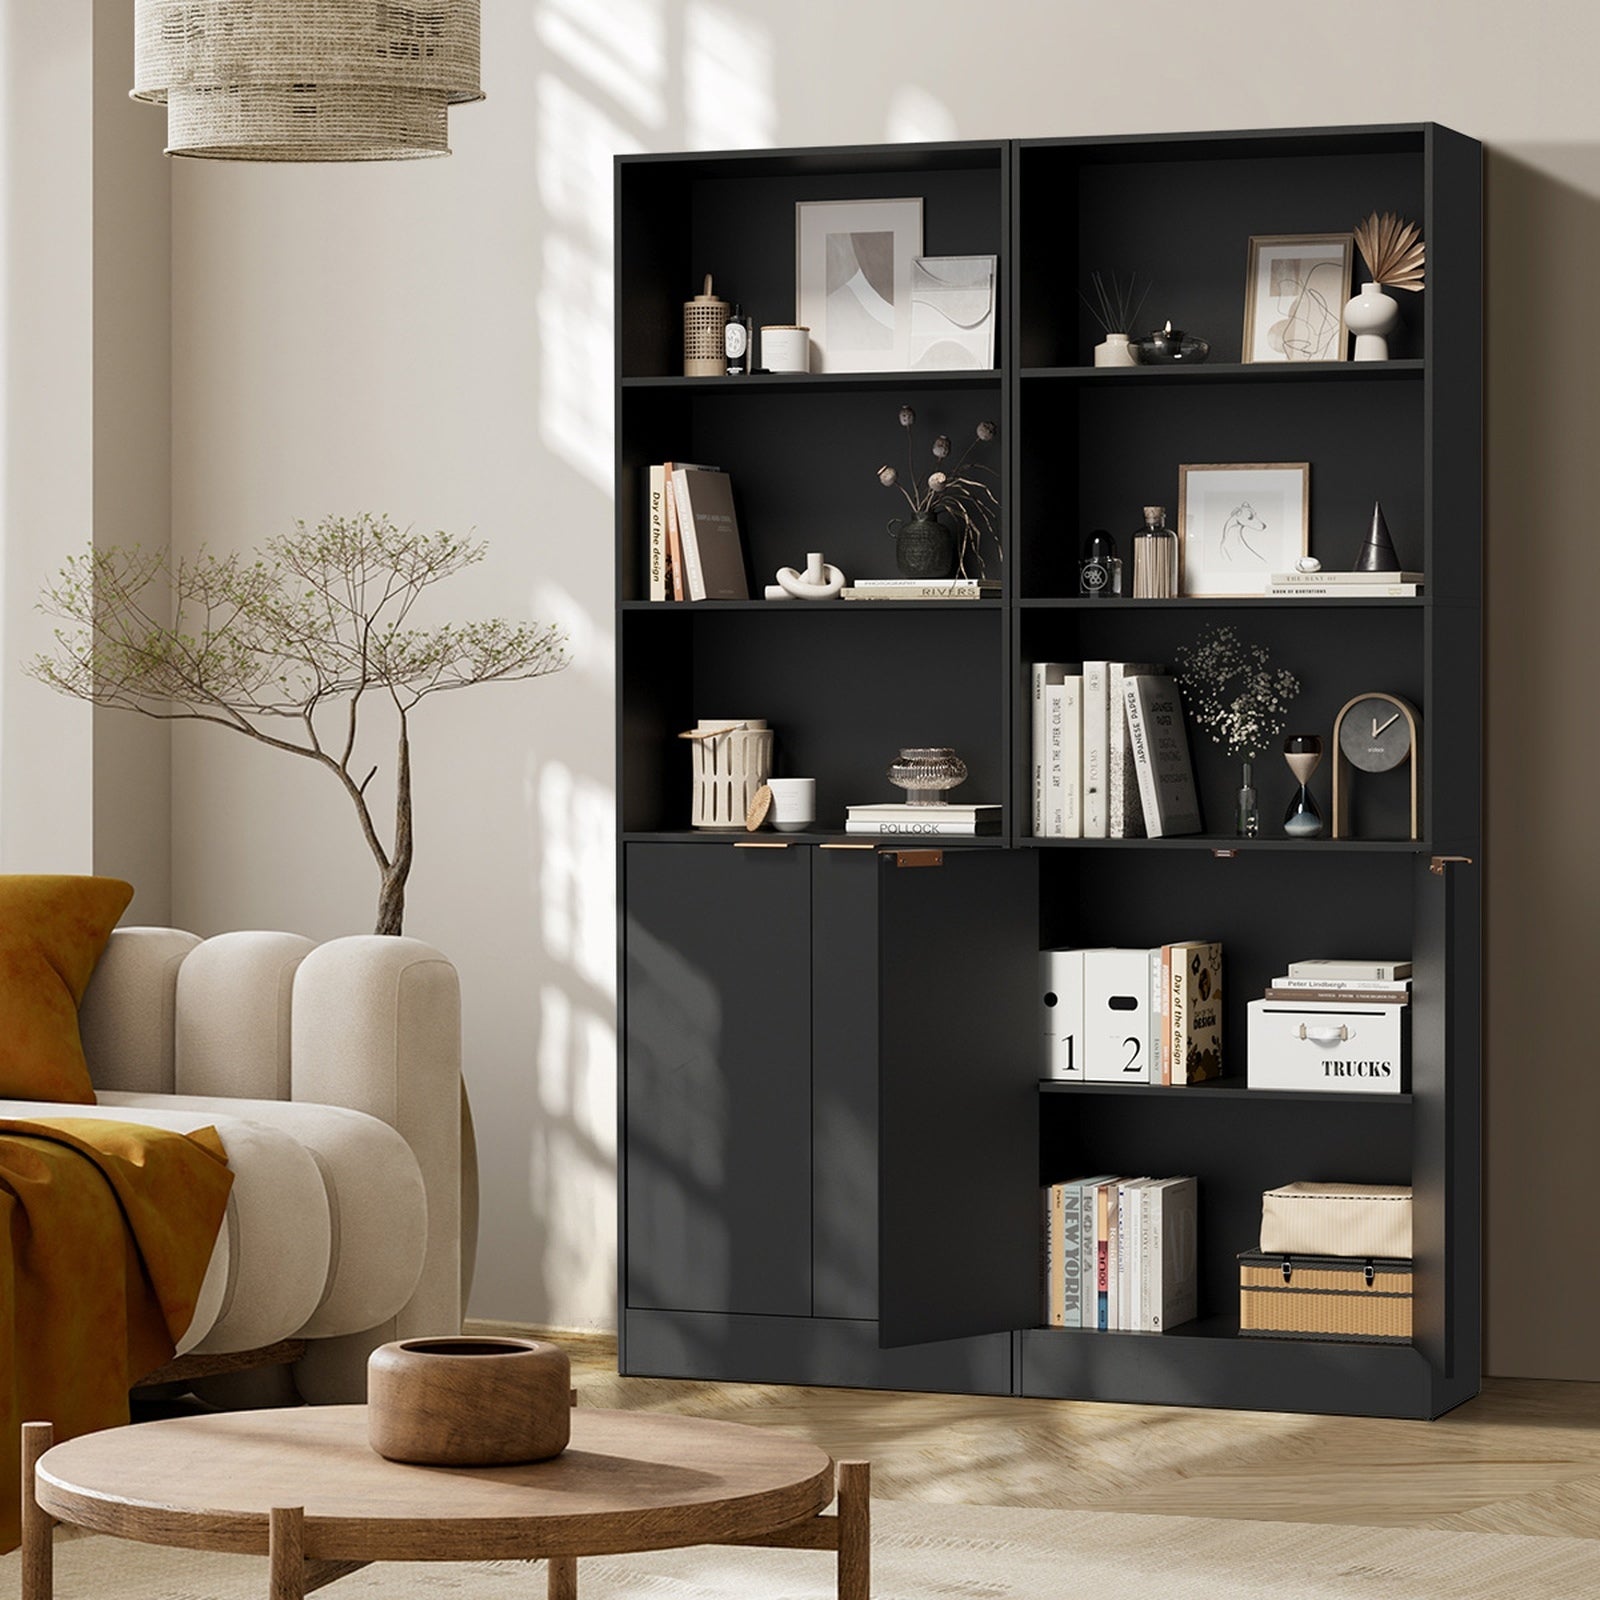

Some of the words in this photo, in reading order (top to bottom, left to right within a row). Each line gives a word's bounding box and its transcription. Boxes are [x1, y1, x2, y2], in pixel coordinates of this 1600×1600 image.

[652, 491, 661, 513] Day
[652, 514, 661, 527] of
[652, 528, 661, 545] the
[651, 547, 661, 582] design
[921, 588, 976, 596] RIVERS
[1052, 697, 1061, 724] CULTURE
[1127, 692, 1139, 720] PAPER
[1052, 727, 1061, 746] AFTER
[1132, 723, 1147, 764] JAPANESE
[1052, 750, 1061, 761] THE
[1090, 749, 1098, 781] POEMS
[1052, 764, 1061, 772] IN
[1052, 776, 1061, 787] ART
[879, 823, 941, 834] POLLOCK
[1172, 974, 1183, 996] Day
[1287, 980, 1307, 988] Peter
[1308, 981, 1347, 989] Lindbergh
[1173, 997, 1183, 1010] of
[1173, 1011, 1182, 1028] the
[1193, 1015, 1217, 1030] DESIGN
[1061, 1034, 1080, 1071] 1
[1122, 1036, 1143, 1072] 2
[1172, 1031, 1182, 1065] design
[1321, 1060, 1392, 1078] TRUCKS
[1065, 1195, 1080, 1245] NEW
[1064, 1247, 1080, 1312] YORK
